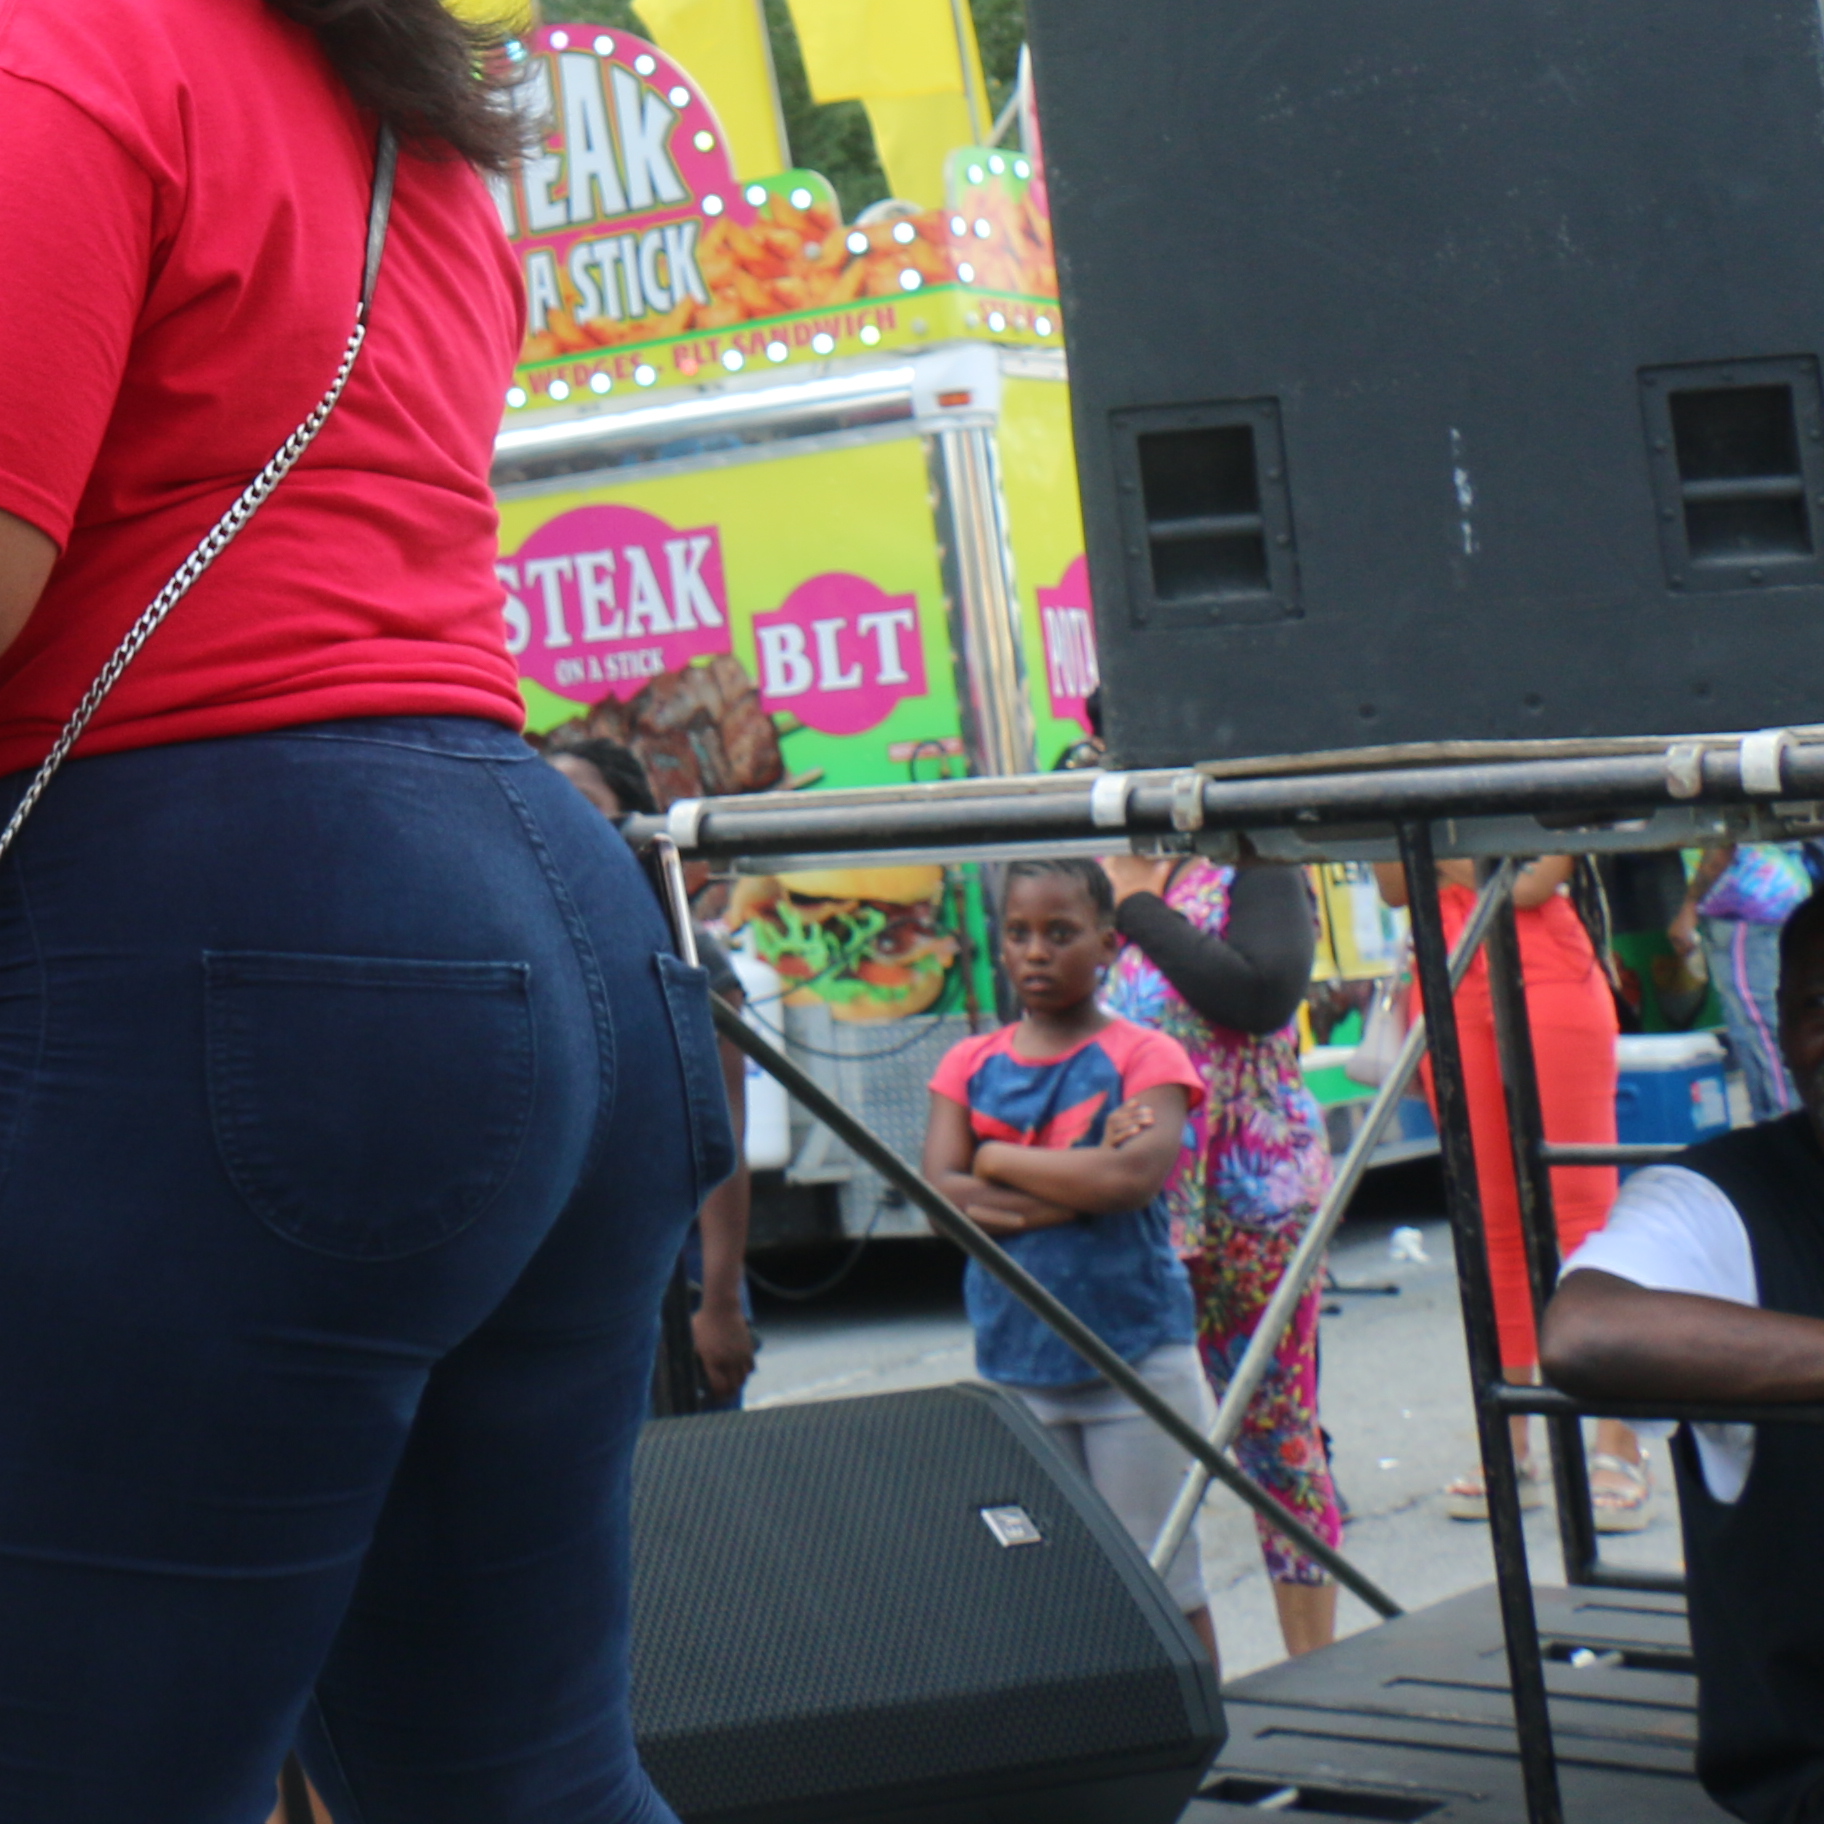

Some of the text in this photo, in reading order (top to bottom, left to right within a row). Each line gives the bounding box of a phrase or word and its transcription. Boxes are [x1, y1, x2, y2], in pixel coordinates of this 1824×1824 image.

[569, 220, 710, 327] STICK
[732, 307, 897, 360] SANDWICH
[494, 535, 725, 656] STEAK
[555, 647, 665, 687] ON A STICK
[756, 609, 916, 698] BLT
